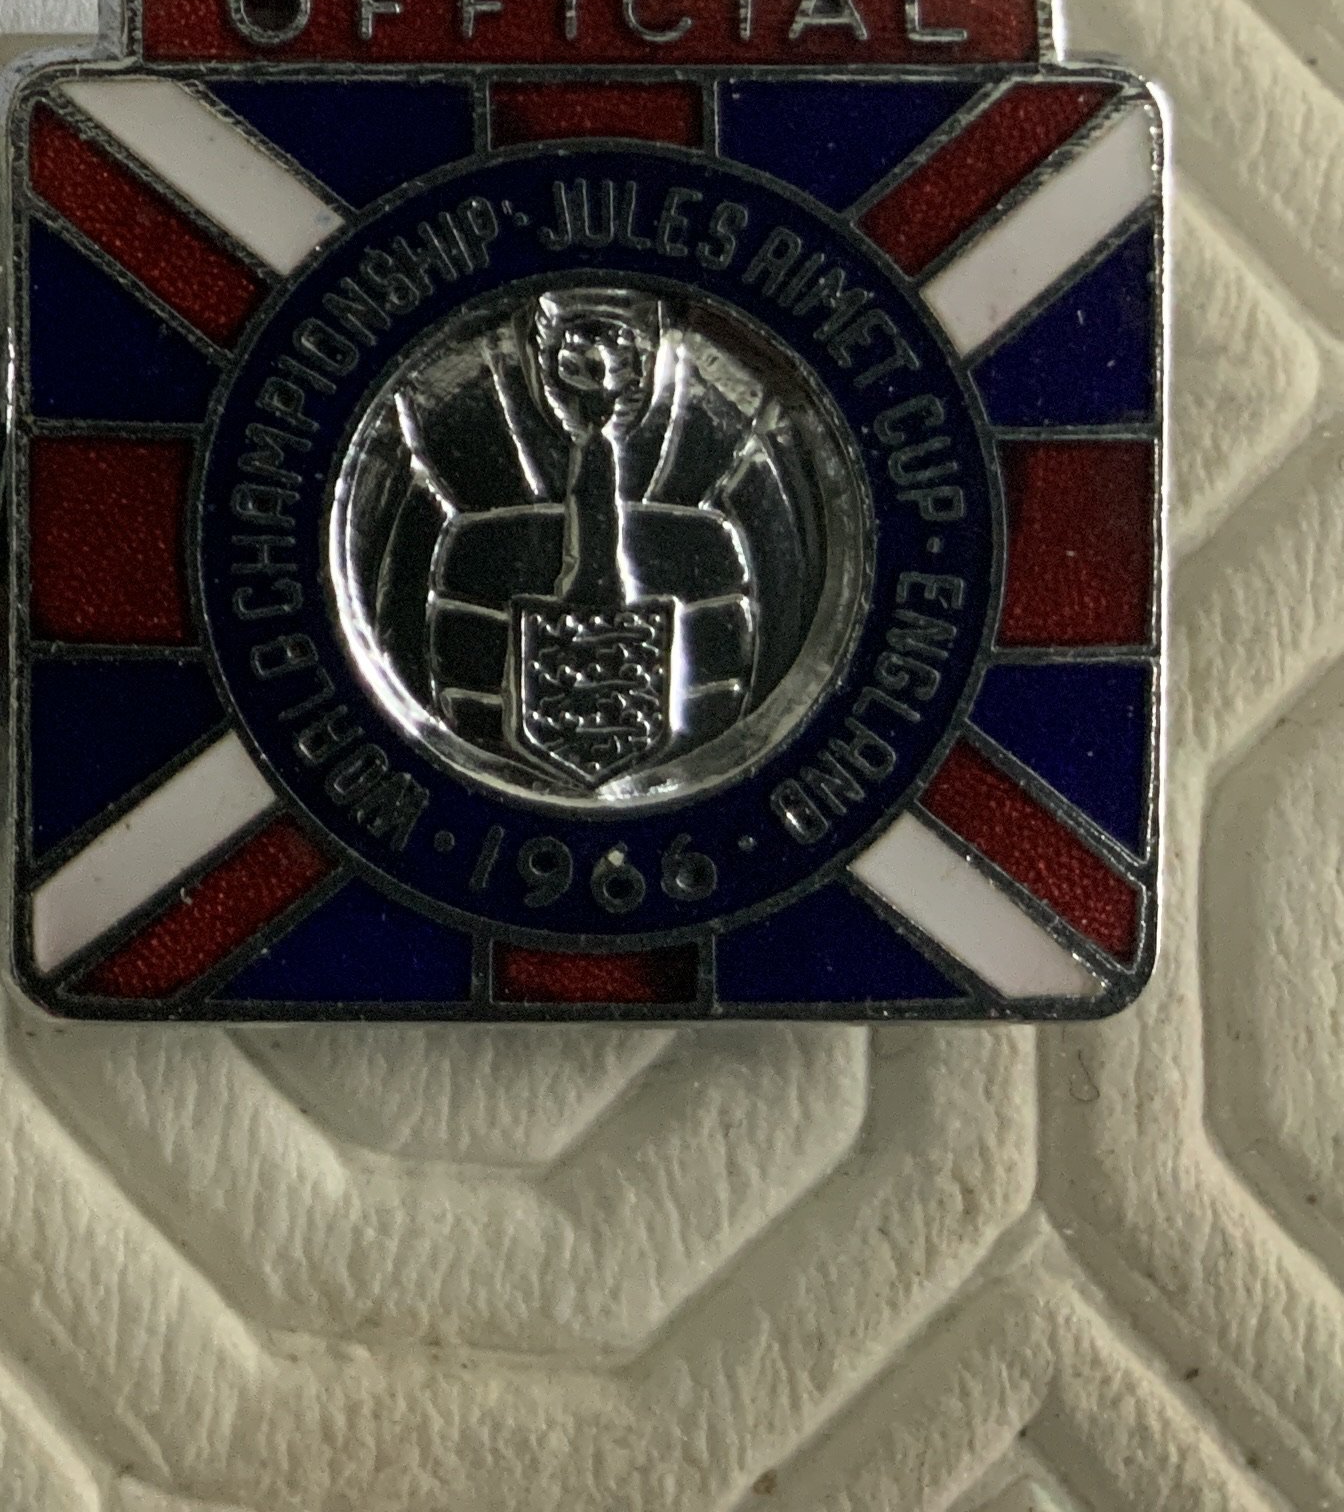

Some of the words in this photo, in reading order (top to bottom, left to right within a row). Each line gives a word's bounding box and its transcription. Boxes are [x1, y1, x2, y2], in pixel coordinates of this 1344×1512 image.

[537, 178, 751, 266] JULES
[739, 225, 920, 395] RIMET
[227, 199, 497, 618] CHAMPIONSHIP
[873, 391, 963, 526] CUP
[248, 626, 432, 852] WORLD
[768, 571, 965, 847] ENGLAND
[468, 824, 718, 914] 1966
